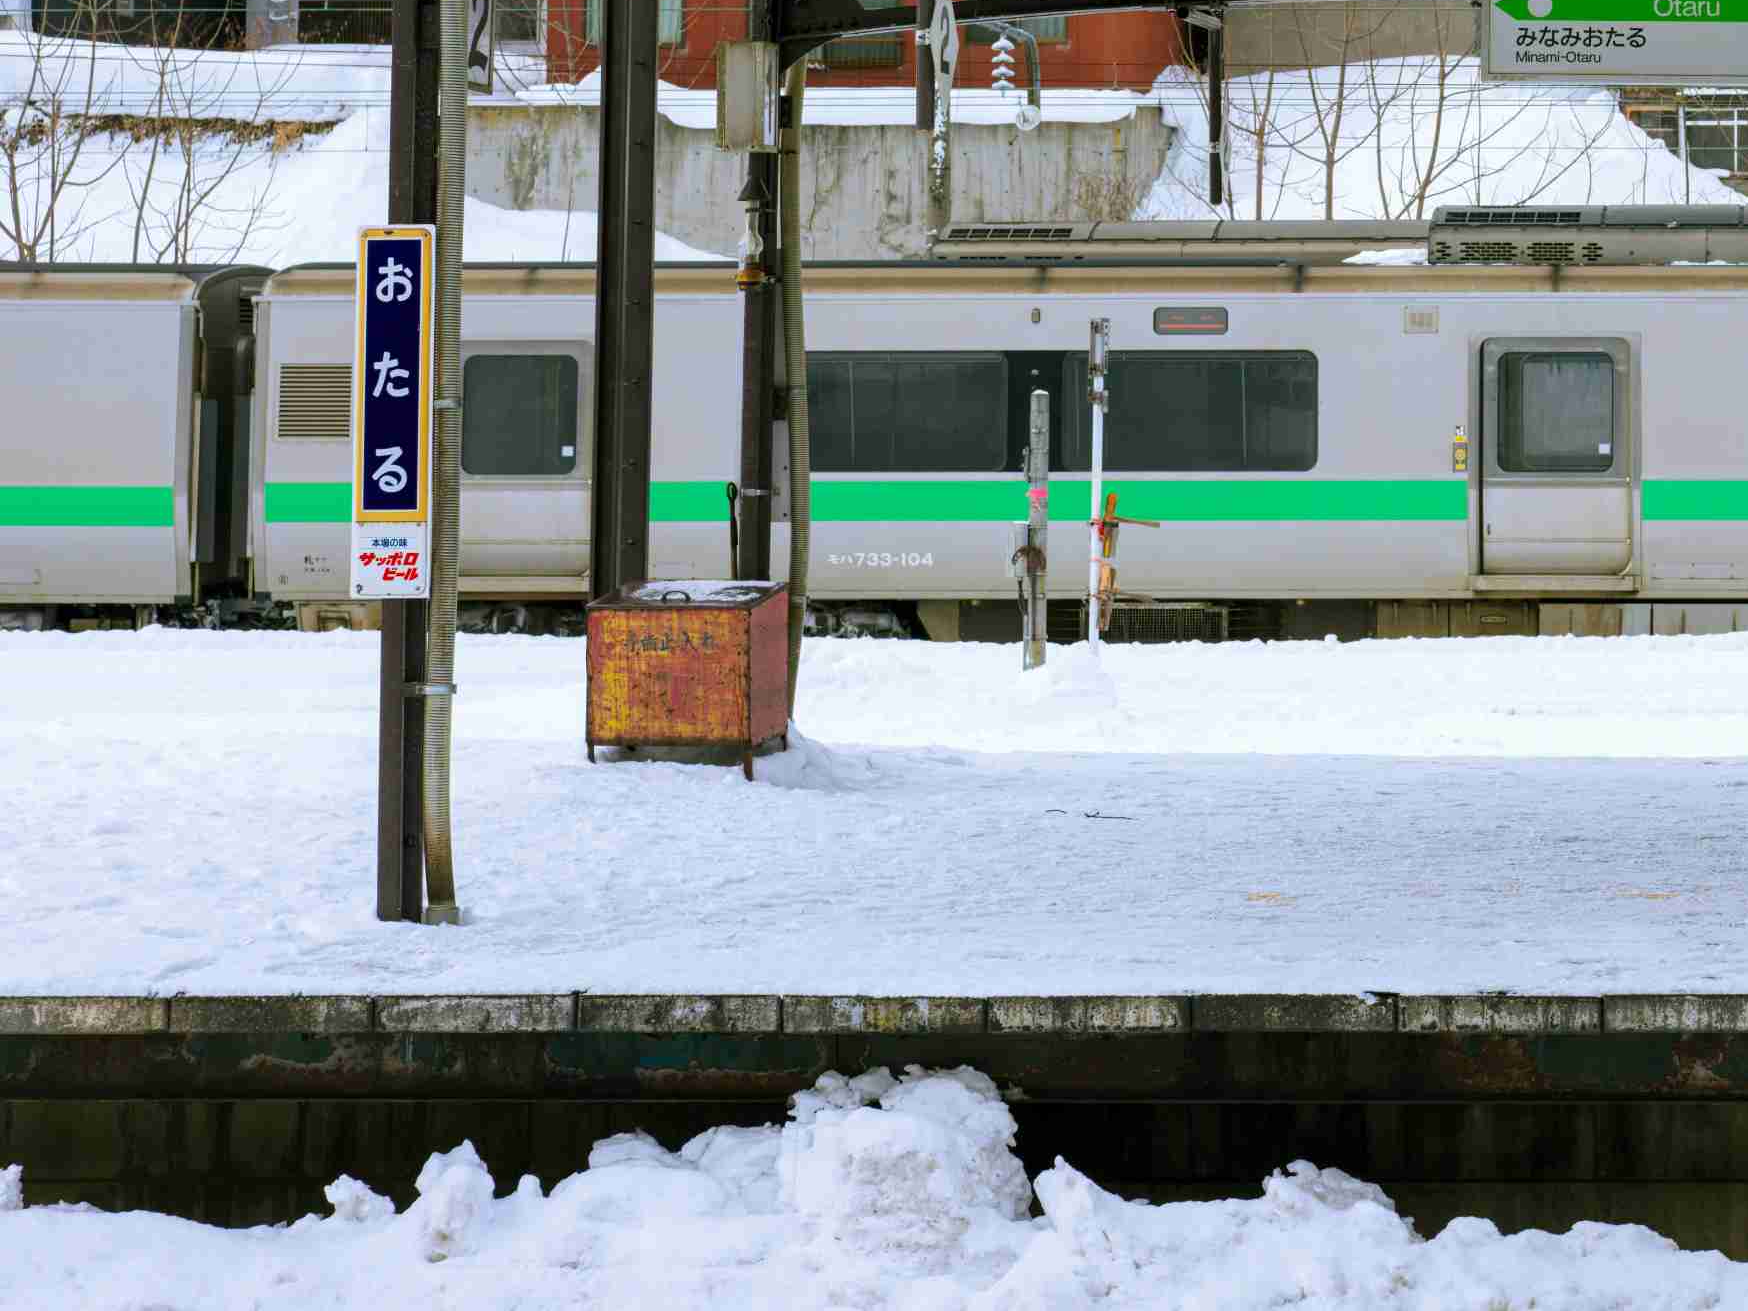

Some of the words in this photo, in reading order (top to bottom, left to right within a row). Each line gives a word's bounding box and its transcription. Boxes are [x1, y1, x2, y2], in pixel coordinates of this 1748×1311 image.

[1515, 25, 1647, 49] みなみおたる
[1515, 50, 1602, 66] Minami-Otaru
[372, 255, 414, 493] おたる
[358, 551, 419, 567] サッポロ
[382, 567, 418, 581] ビール
